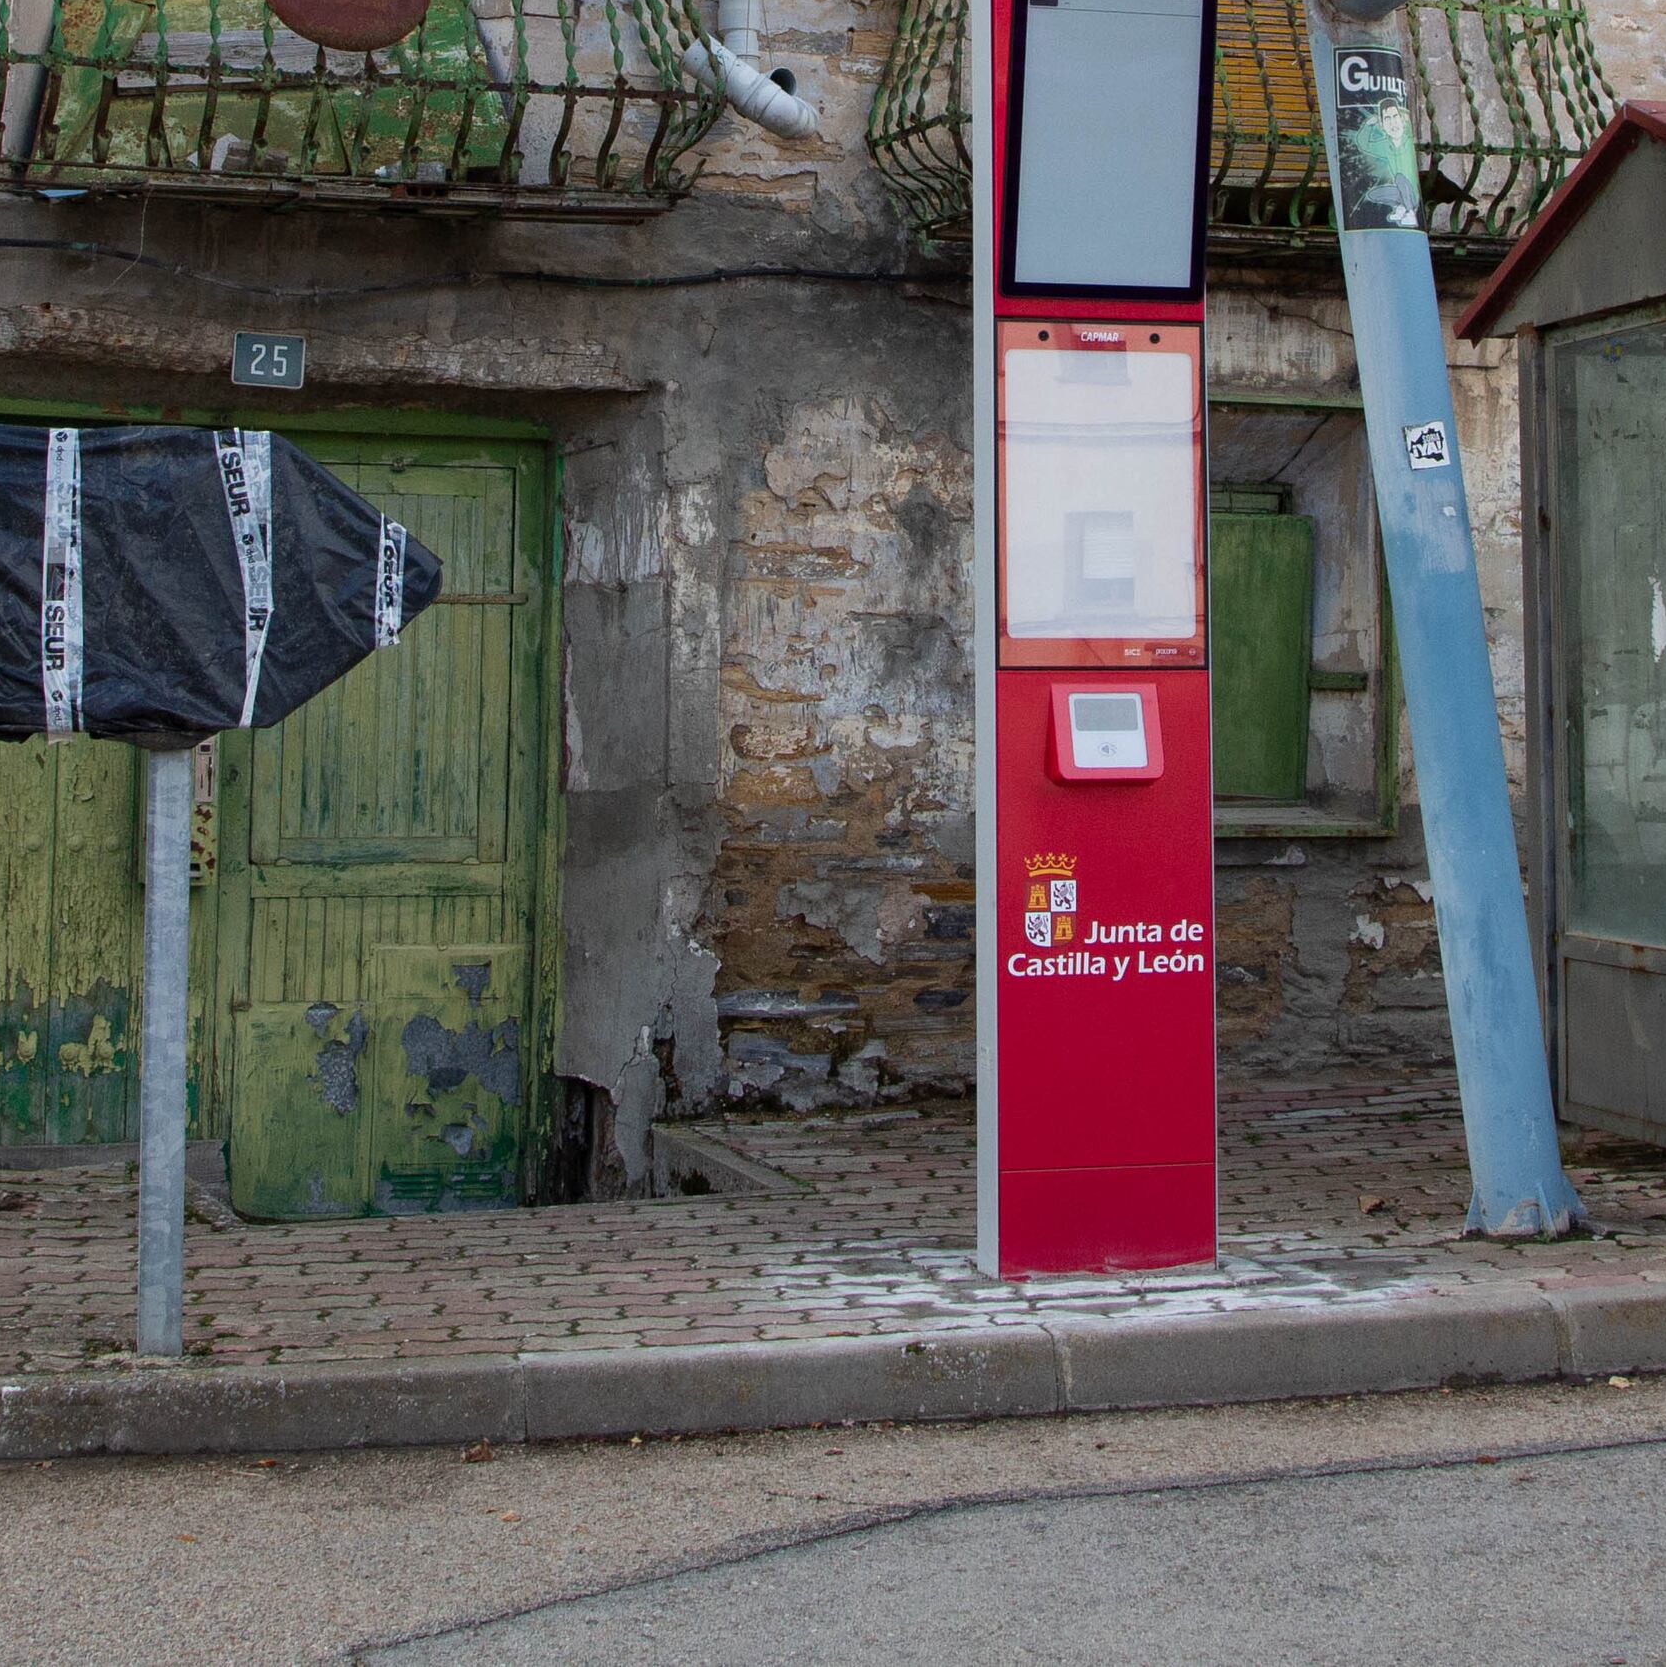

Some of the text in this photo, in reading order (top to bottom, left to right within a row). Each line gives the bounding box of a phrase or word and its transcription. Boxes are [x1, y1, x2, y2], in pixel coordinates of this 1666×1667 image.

[1080, 330, 1119, 343] CAPMAR
[250, 343, 289, 377] 25
[221, 451, 251, 518] SEUR
[45, 605, 65, 672] SEUR
[1084, 919, 1204, 945] Junta de
[1007, 948, 1205, 982] Castilla y León
